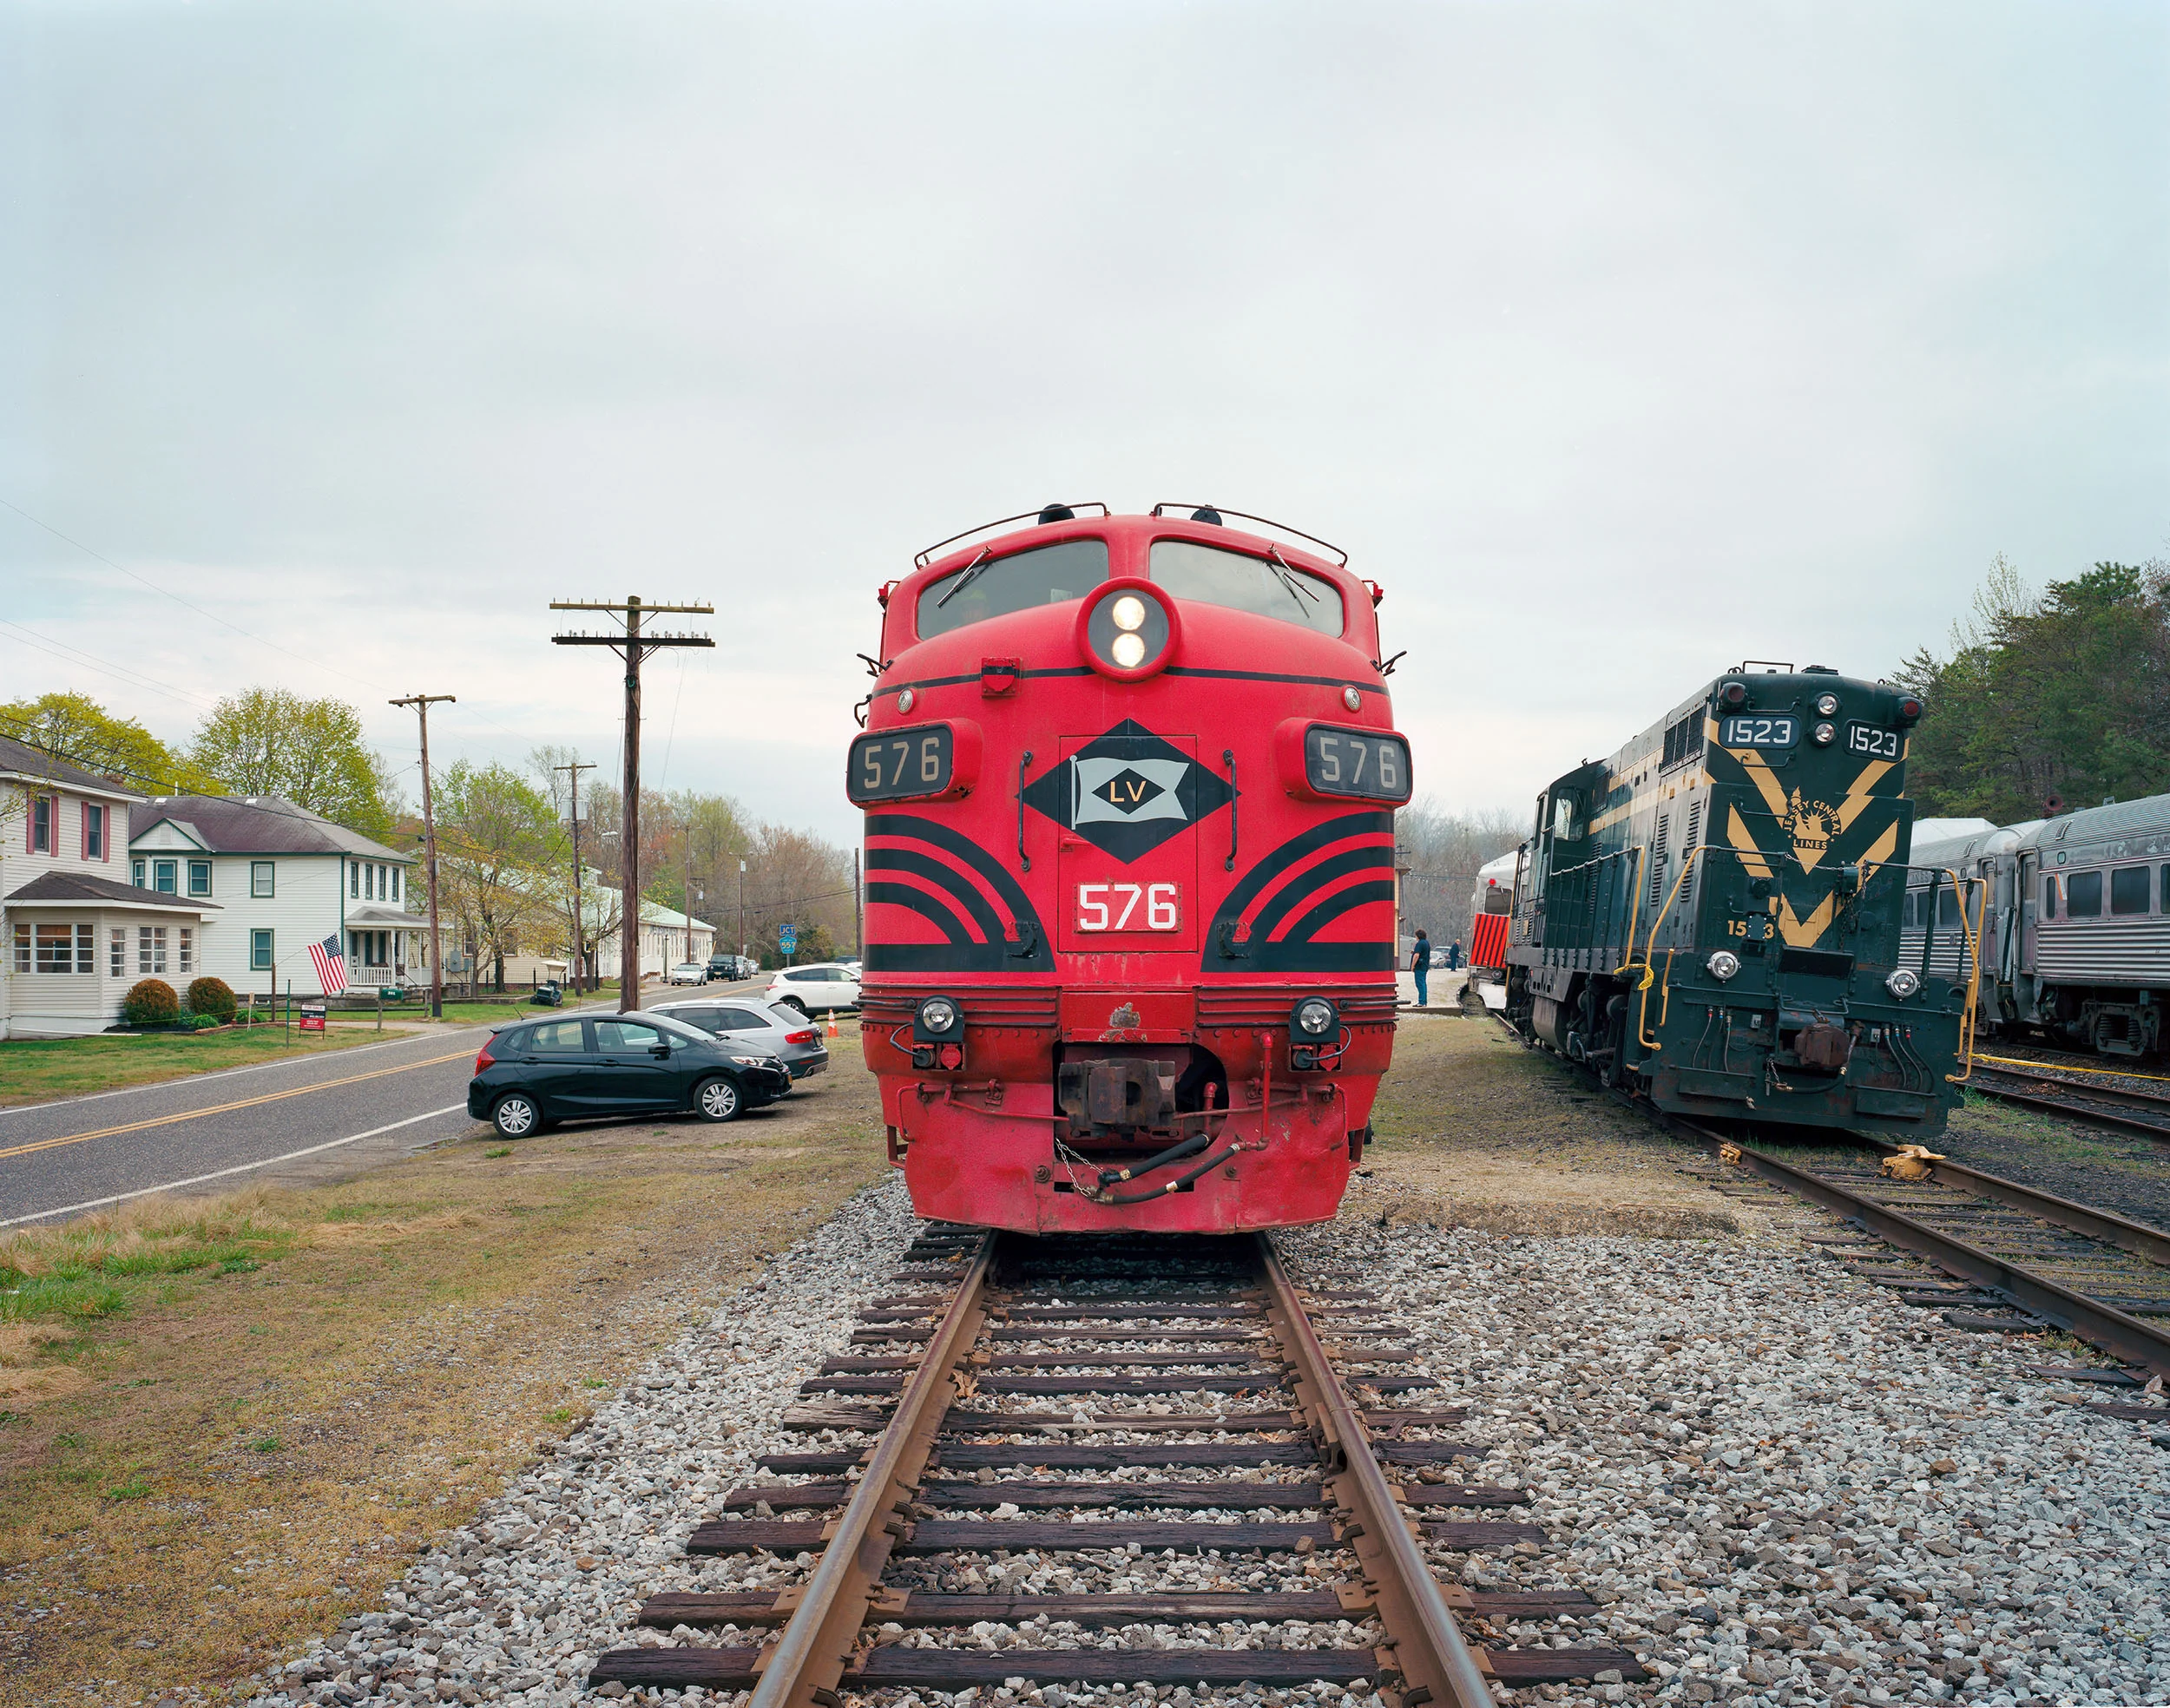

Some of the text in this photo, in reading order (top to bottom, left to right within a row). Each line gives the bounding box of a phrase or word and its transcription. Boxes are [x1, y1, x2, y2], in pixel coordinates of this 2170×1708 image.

[1727, 719, 1792, 744] 1523
[1850, 726, 1897, 757] 1523
[864, 737, 940, 789] 576
[1320, 737, 1397, 789] 576
[1110, 781, 1147, 802] LV
[1812, 800, 1841, 835] CENTRAL
[1792, 839, 1827, 850] LINES
[1080, 884, 1176, 930] 576
[1727, 920, 1774, 939] 153
